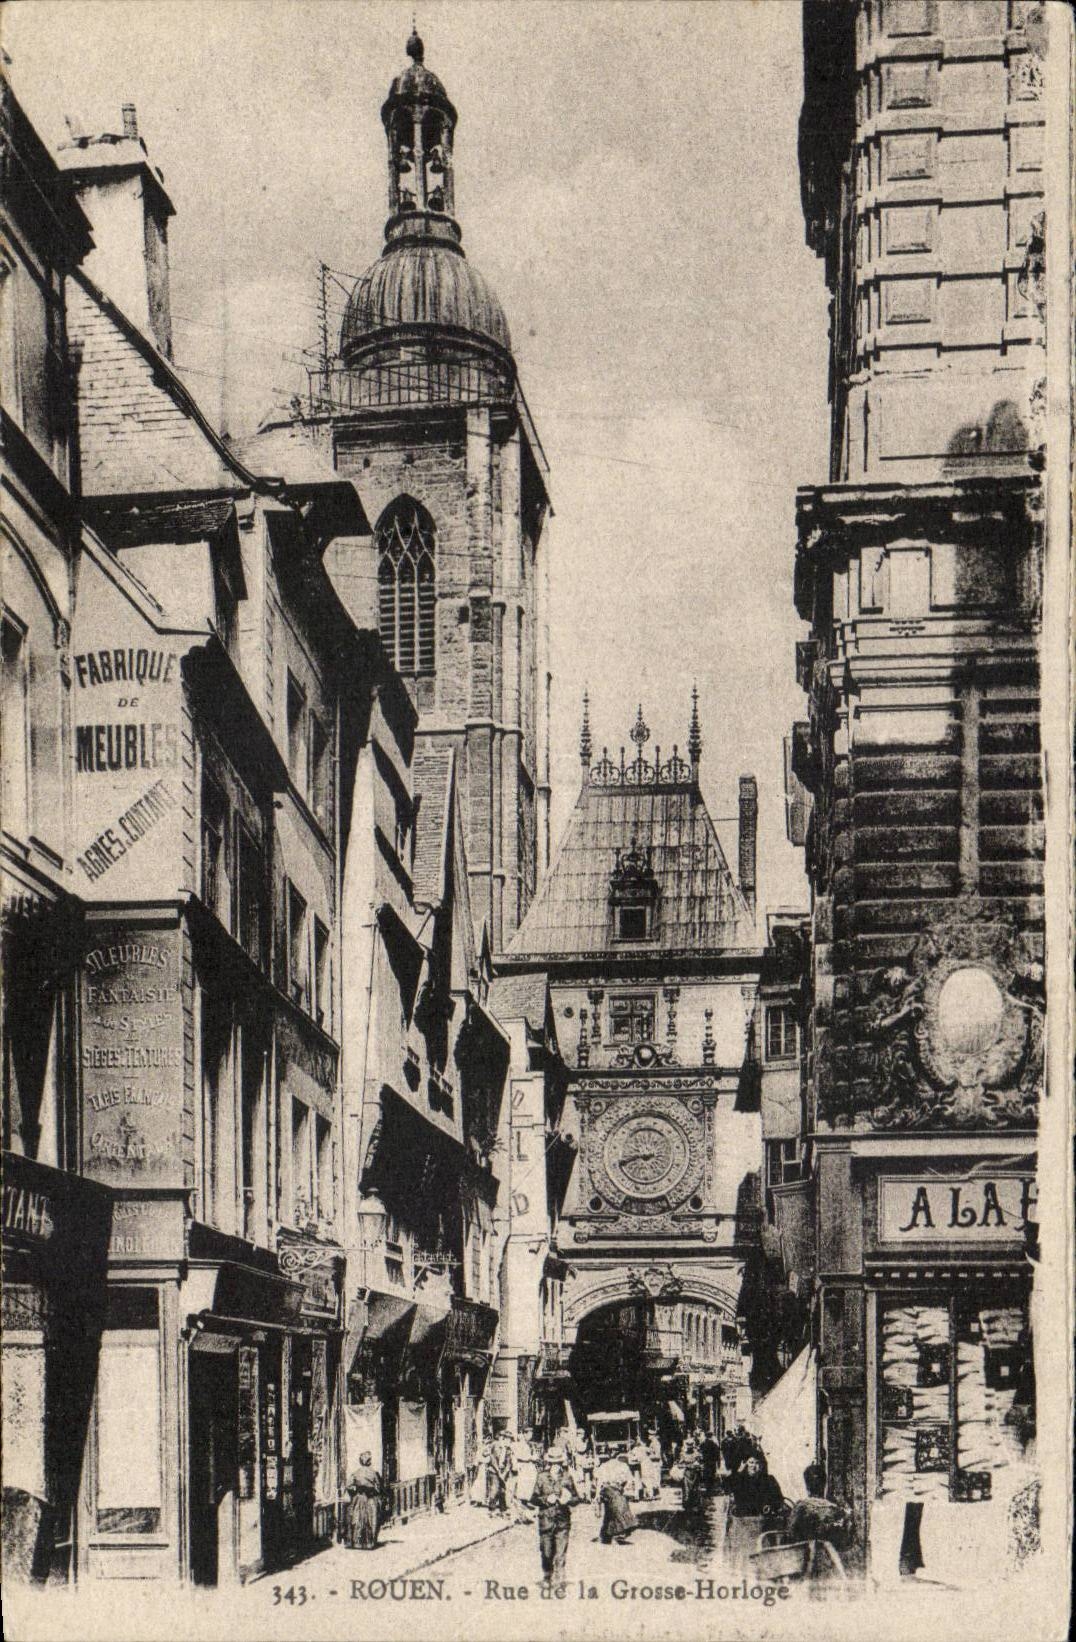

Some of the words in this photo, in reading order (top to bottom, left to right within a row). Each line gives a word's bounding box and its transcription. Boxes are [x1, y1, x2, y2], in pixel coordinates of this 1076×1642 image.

[74, 648, 177, 688] FABRIQUE
[117, 697, 139, 707] DE
[76, 723, 179, 772] MEUBLES
[899, 1186, 935, 1232] A
[948, 1182, 1008, 1229] LA
